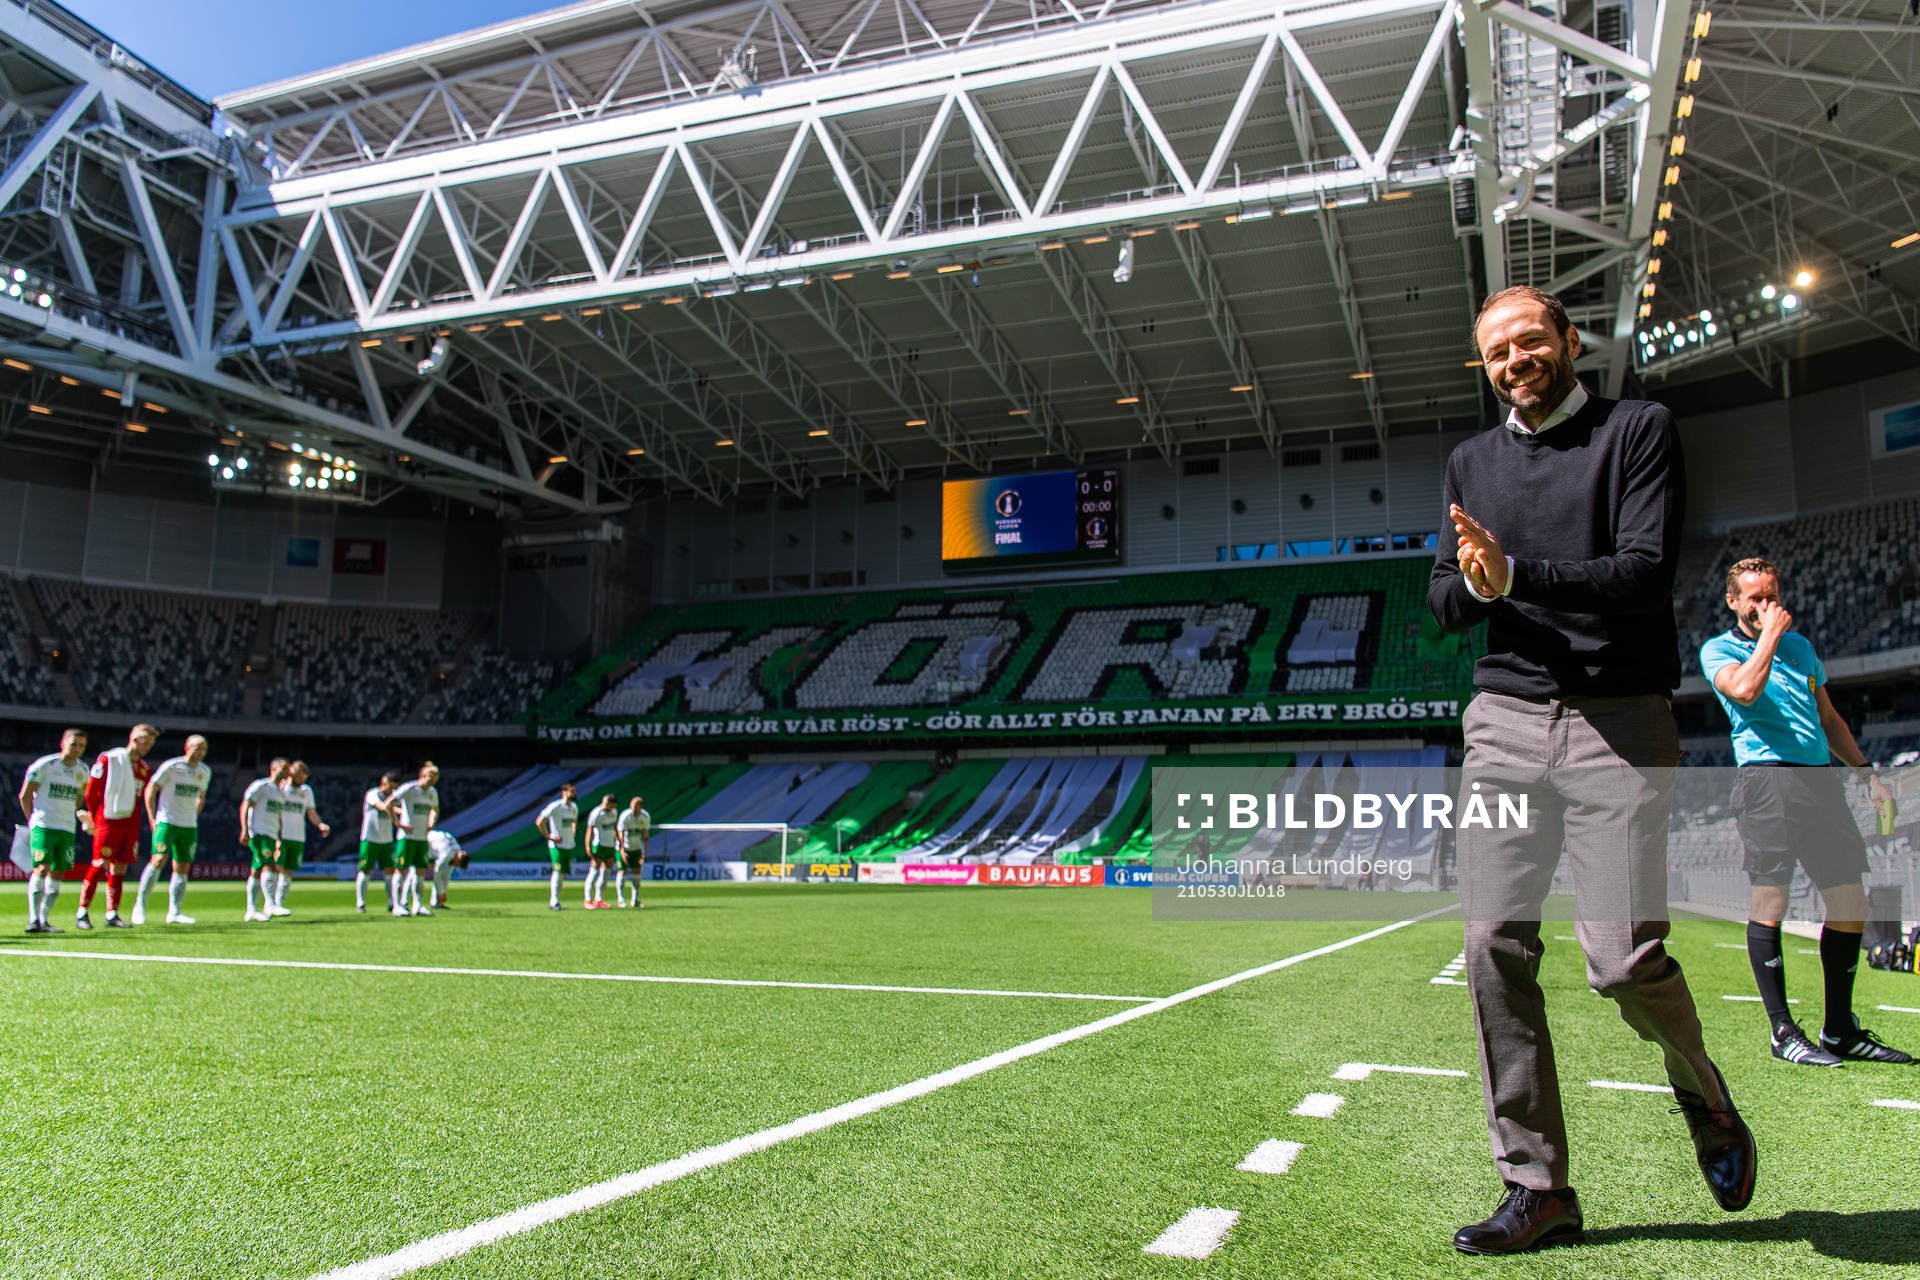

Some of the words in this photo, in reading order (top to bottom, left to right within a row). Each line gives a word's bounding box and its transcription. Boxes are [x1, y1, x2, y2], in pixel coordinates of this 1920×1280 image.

[1081, 482, 1090, 494] 0
[1103, 480, 1112, 493] 0
[1082, 501, 1112, 513] 00:00
[995, 531, 1022, 545] FINAL
[598, 723, 633, 740] OM
[637, 722, 663, 737] NI
[667, 721, 723, 736] INTE
[726, 716, 779, 734] HÖR
[784, 715, 837, 734] VÅR
[841, 713, 909, 732] RÖST
[926, 710, 982, 730] GÖR
[987, 712, 1056, 729] ALLT
[1061, 706, 1117, 727] FÖR
[1122, 707, 1224, 725] FANAN
[1230, 701, 1271, 723] PÅ
[1277, 703, 1337, 721] ERT
[1343, 697, 1458, 720] BRÖST!
[652, 864, 734, 881] Borohus
[754, 863, 795, 877] FAST
[810, 863, 853, 877] FAST
[990, 866, 1092, 883] BAUHAUS
[1132, 872, 1187, 882] SVENSKA
[1188, 872, 1229, 883] CUPEN
